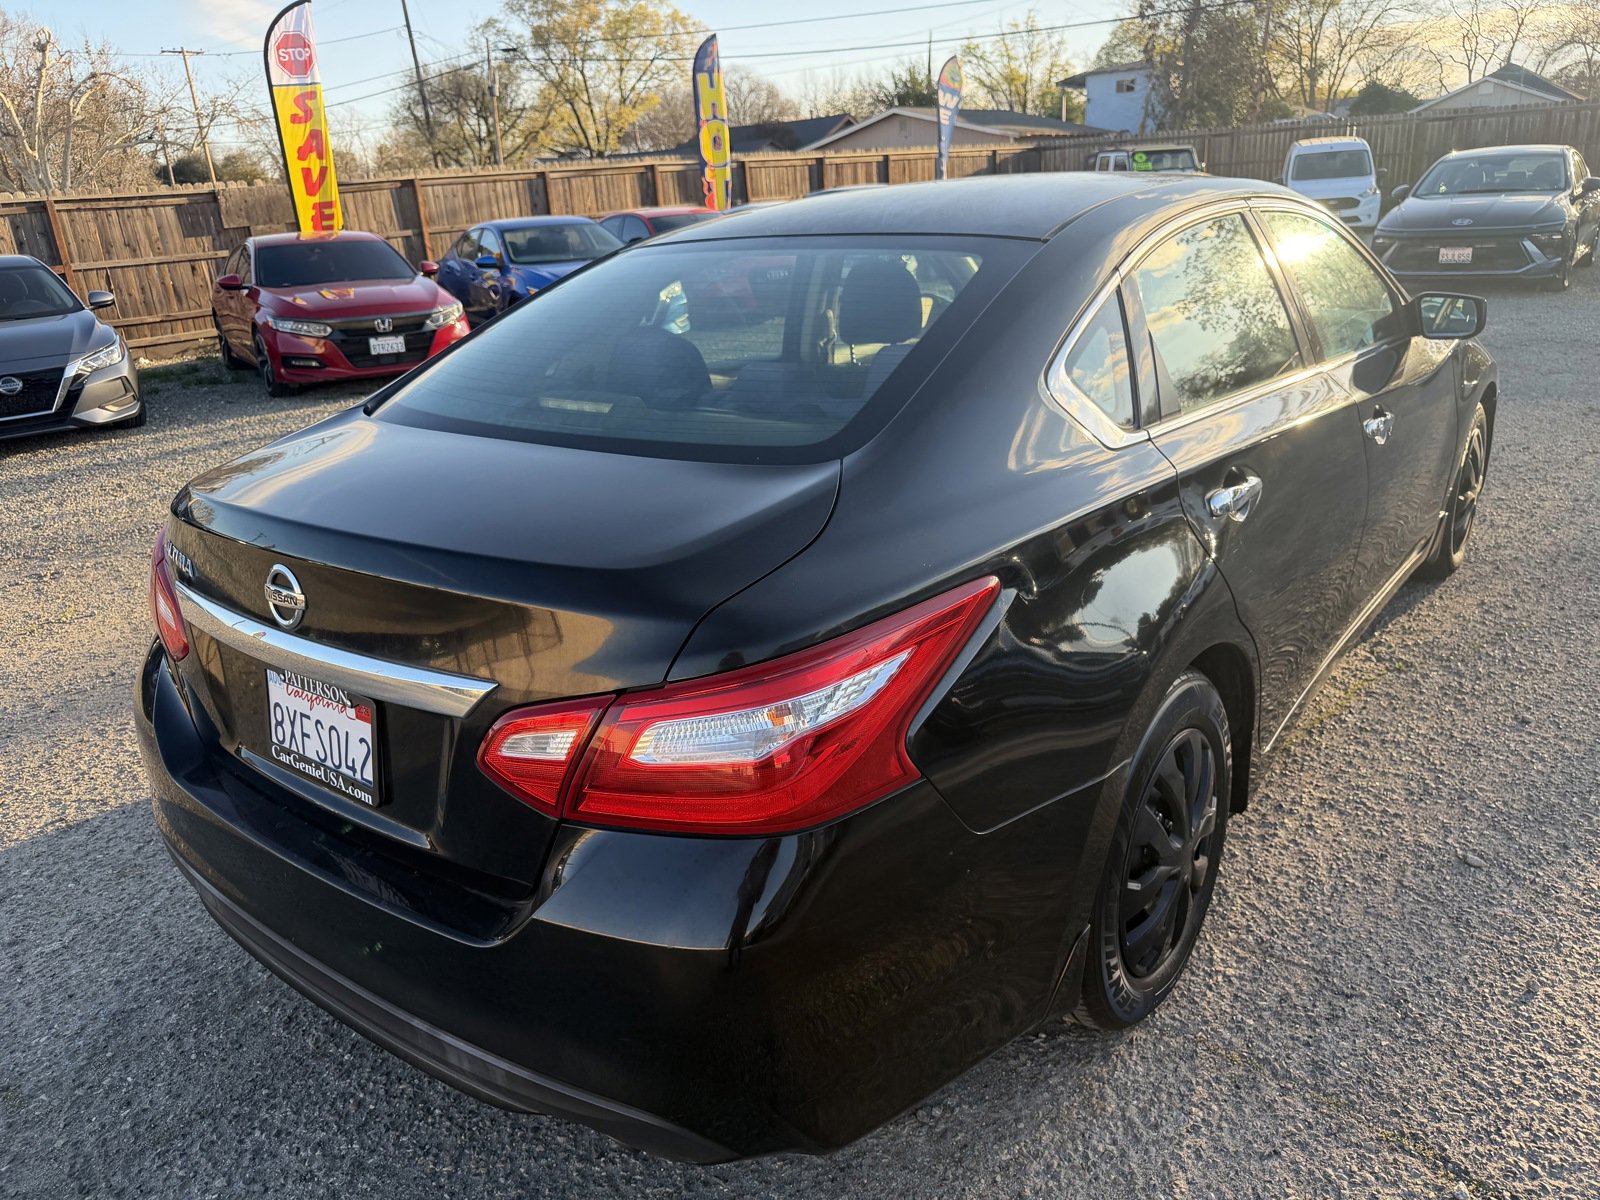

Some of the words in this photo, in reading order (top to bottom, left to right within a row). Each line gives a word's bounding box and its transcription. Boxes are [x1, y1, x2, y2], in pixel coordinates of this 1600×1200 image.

[279, 48, 311, 62] STOP
[290, 90, 336, 231] SAVE
[265, 588, 298, 606] NISSAN
[284, 669, 349, 705] PATTERSON
[273, 701, 373, 786] 8XFS042
[271, 744, 373, 805] CarGenieUSA.com
